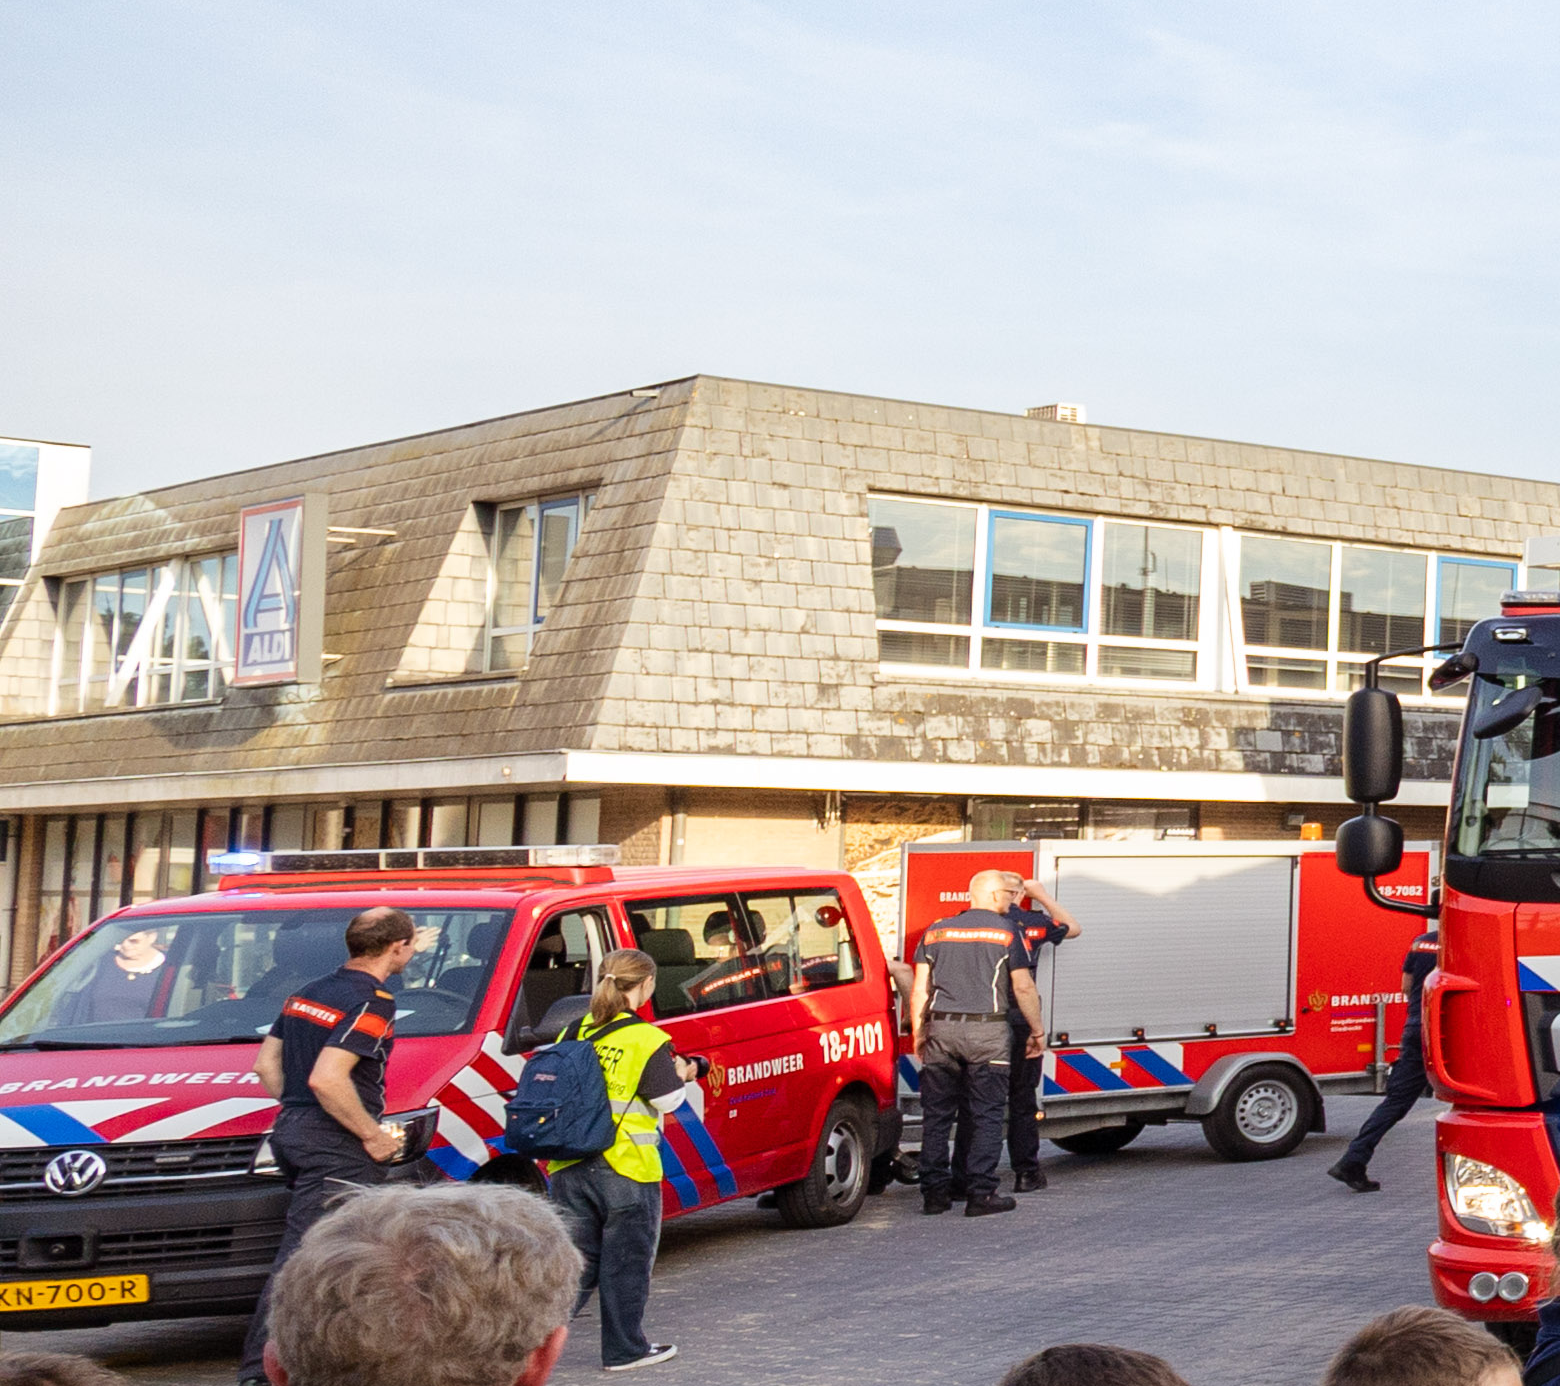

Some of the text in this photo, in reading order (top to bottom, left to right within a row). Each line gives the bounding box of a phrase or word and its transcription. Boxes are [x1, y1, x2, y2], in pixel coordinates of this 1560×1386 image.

[246, 631, 292, 664] ALDI
[939, 891, 971, 902] BRAND
[1377, 886, 1424, 897] 18-7082
[819, 1021, 884, 1064] 18-7101
[0, 1072, 261, 1094] BRANDWEER
[728, 1053, 804, 1086] BRANDWEER
